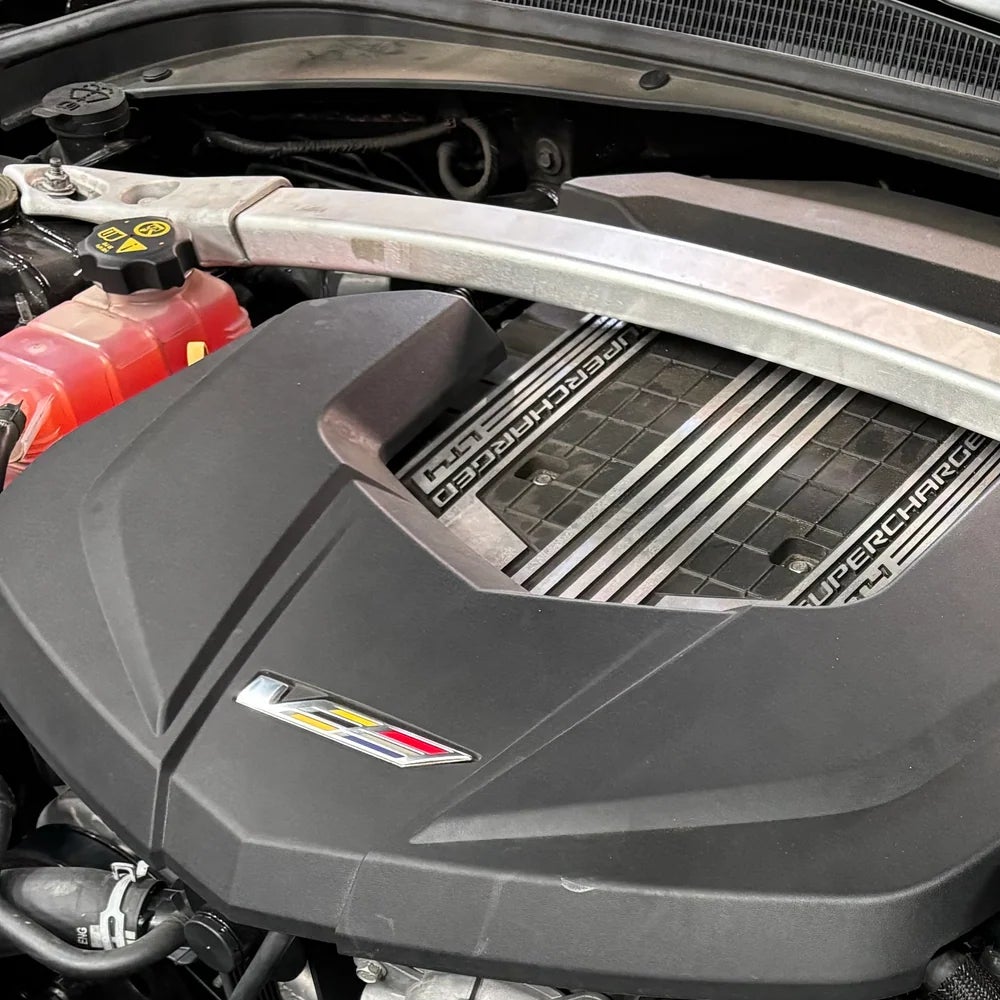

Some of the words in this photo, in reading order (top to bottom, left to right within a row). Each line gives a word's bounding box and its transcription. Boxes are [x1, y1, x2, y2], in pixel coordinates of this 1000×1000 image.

[431, 324, 643, 508] UPERCHARGED
[424, 430, 483, 482] LT4
[800, 431, 988, 606] UPERCHARGE
[843, 564, 893, 604] T4
[76, 926, 89, 945] ENG
